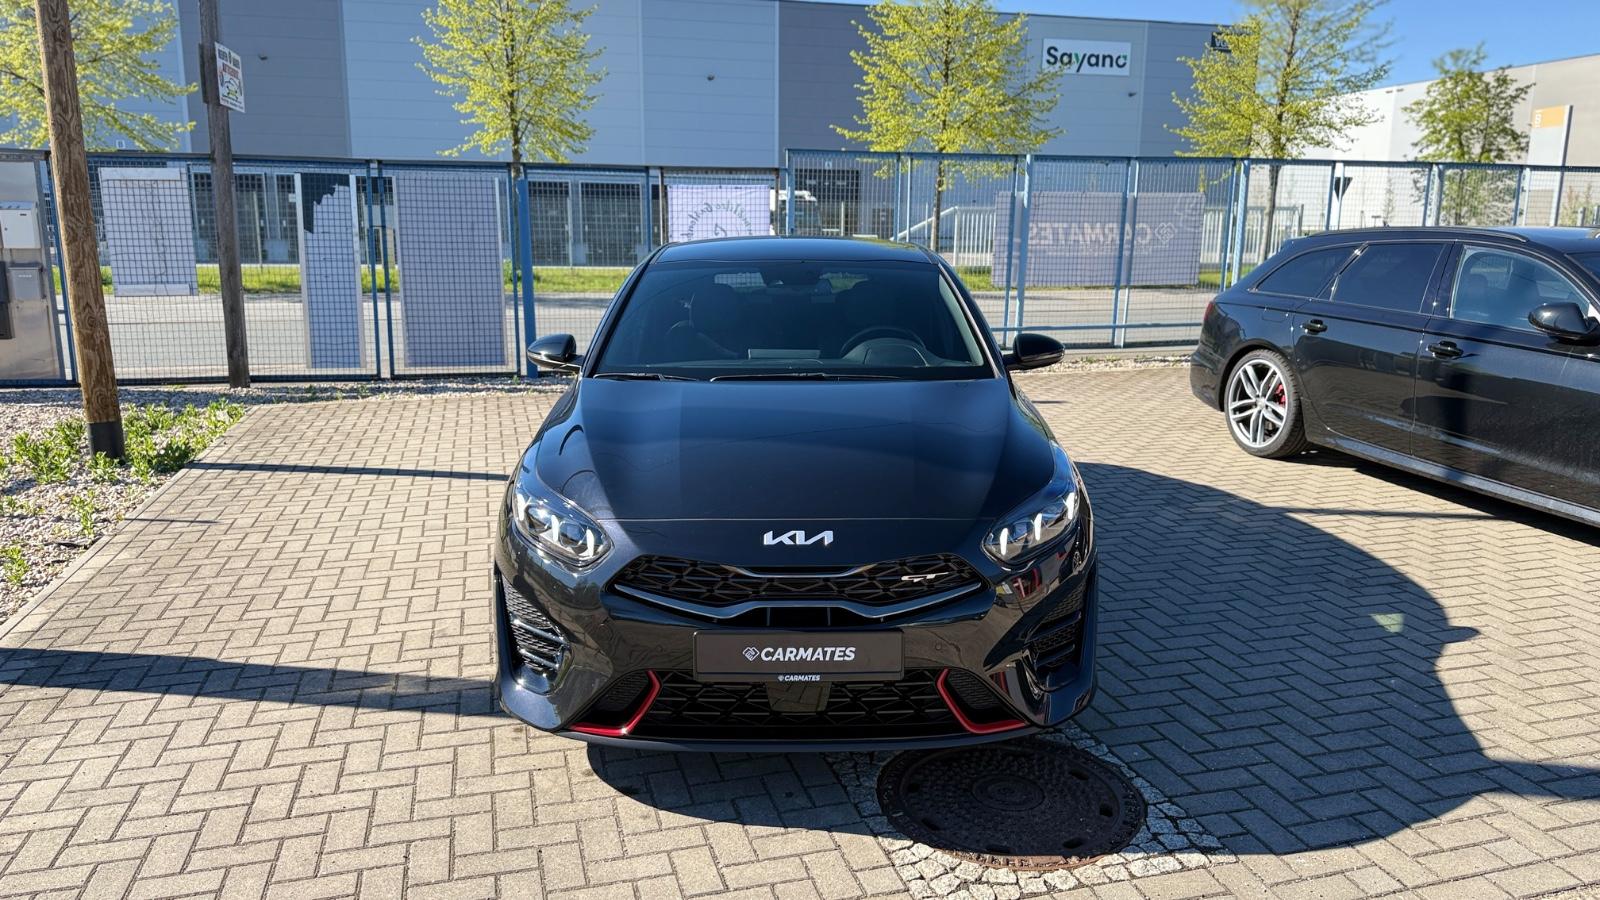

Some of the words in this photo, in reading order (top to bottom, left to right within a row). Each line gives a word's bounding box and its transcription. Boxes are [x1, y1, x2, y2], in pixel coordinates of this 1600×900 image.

[763, 530, 834, 546] KIA
[900, 571, 950, 583] GT
[760, 646, 857, 662] CARMATES
[784, 674, 821, 682] CARMATES
